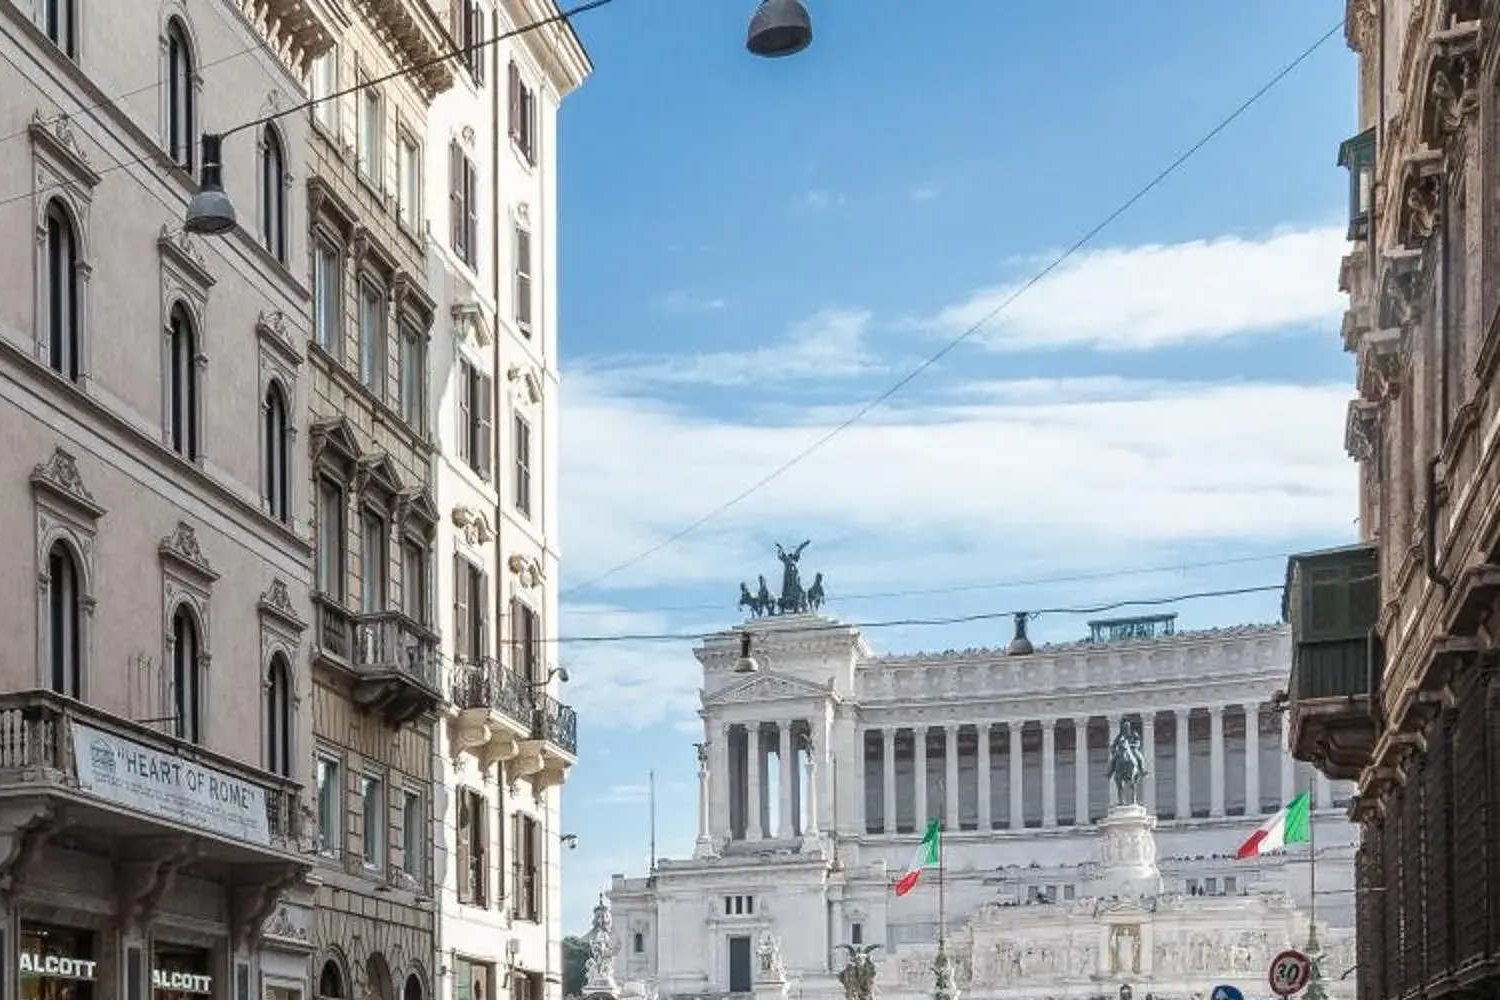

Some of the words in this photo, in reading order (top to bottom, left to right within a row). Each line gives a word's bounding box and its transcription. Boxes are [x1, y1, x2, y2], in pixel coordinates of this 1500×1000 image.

[186, 769, 205, 792] OF
[19, 952, 97, 978] ALCOTT
[1277, 961, 1300, 984] 30
[151, 969, 213, 992] ALCOTT
